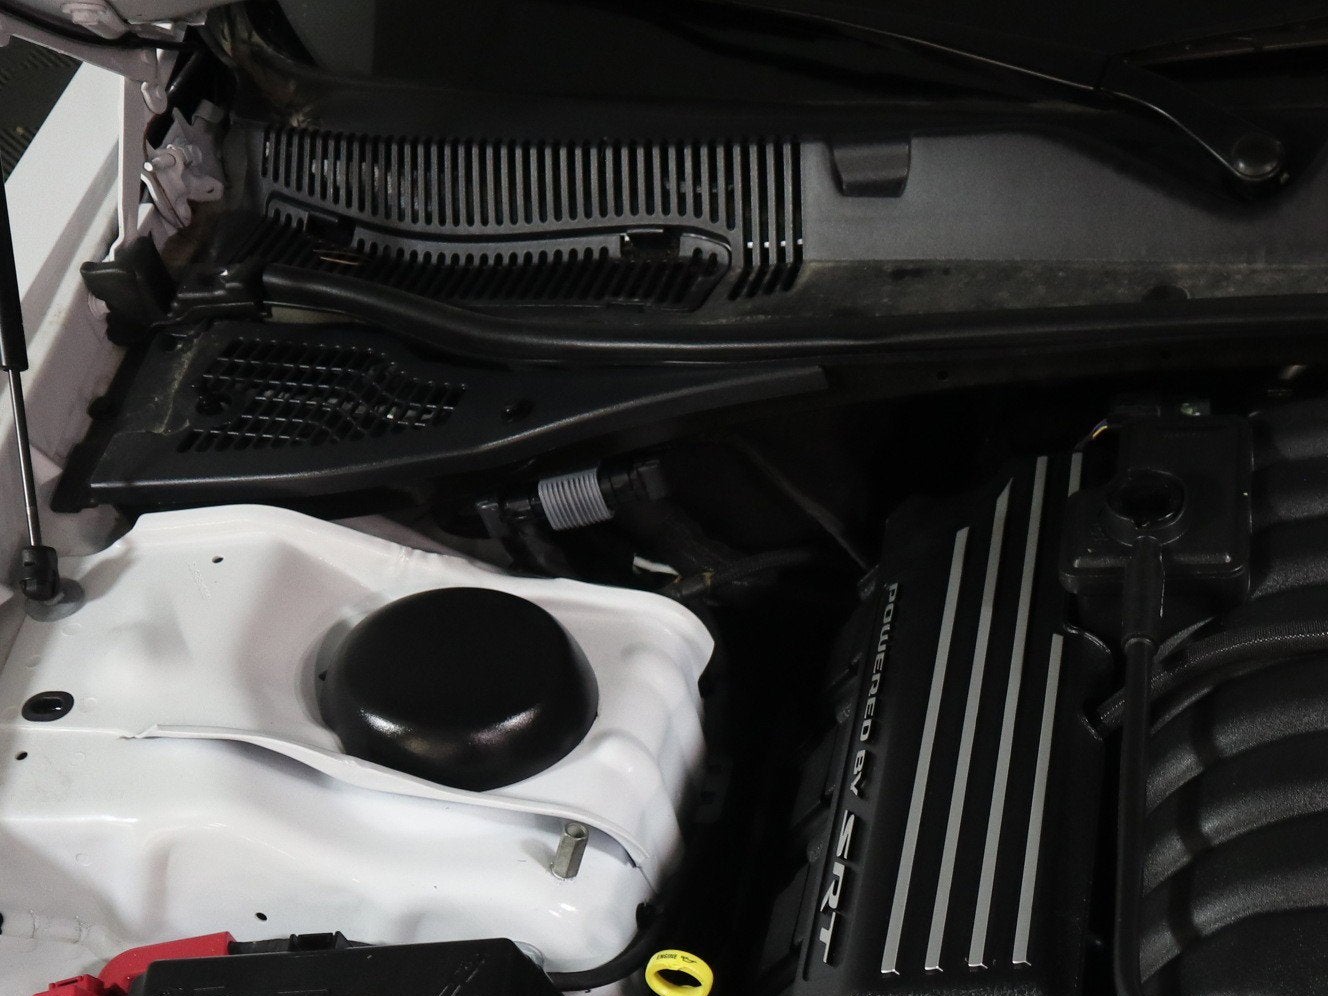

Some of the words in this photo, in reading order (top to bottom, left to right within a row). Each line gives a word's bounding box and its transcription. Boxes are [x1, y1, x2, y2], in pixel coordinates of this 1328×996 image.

[858, 581, 900, 741] POWERED
[849, 749, 867, 797] BY
[819, 809, 856, 963] SRT
